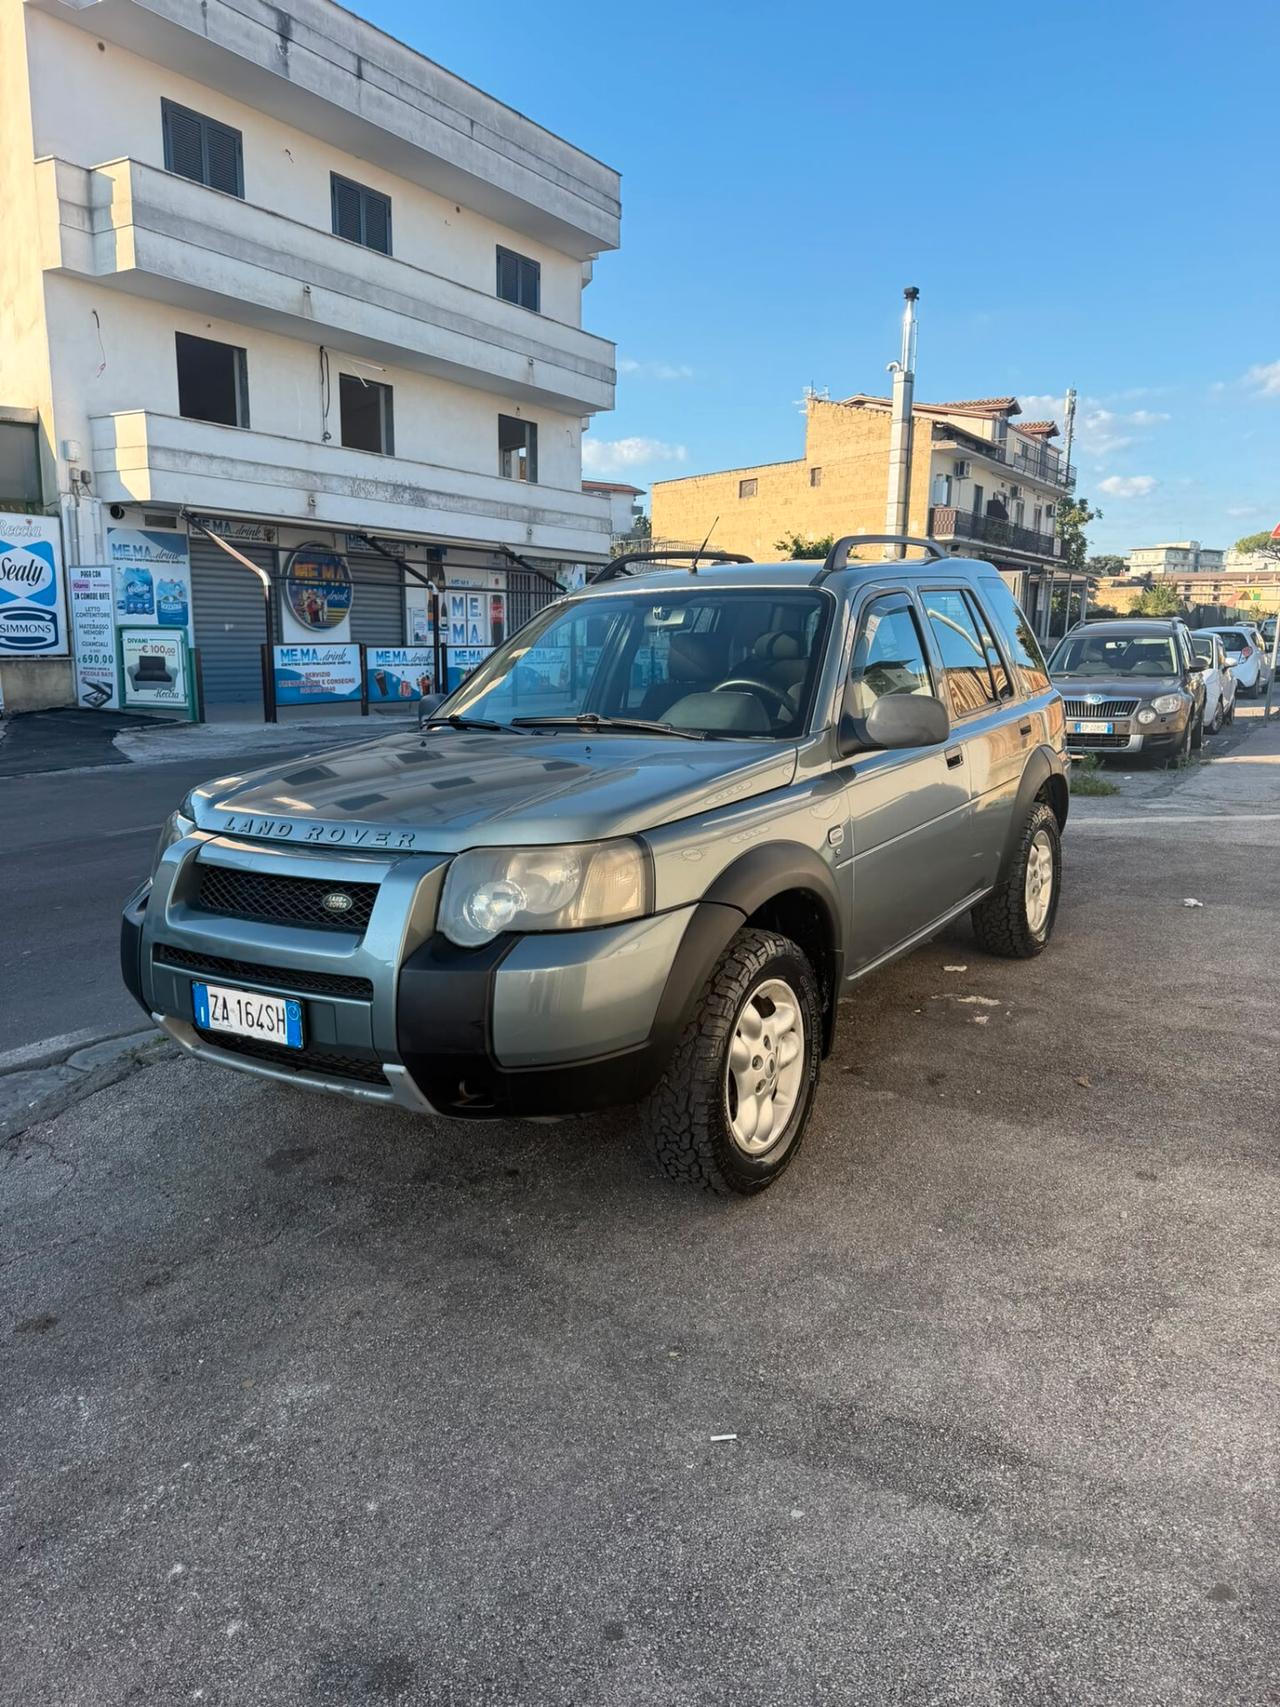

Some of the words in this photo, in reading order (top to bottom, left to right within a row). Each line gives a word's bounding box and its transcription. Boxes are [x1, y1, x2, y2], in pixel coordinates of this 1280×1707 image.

[0, 557, 43, 587] Sealy
[0, 623, 52, 634] SIMMONS
[223, 816, 293, 838] LAND
[304, 826, 417, 848] ROVER
[210, 994, 230, 1022] ZA
[236, 999, 286, 1035] 164SH
